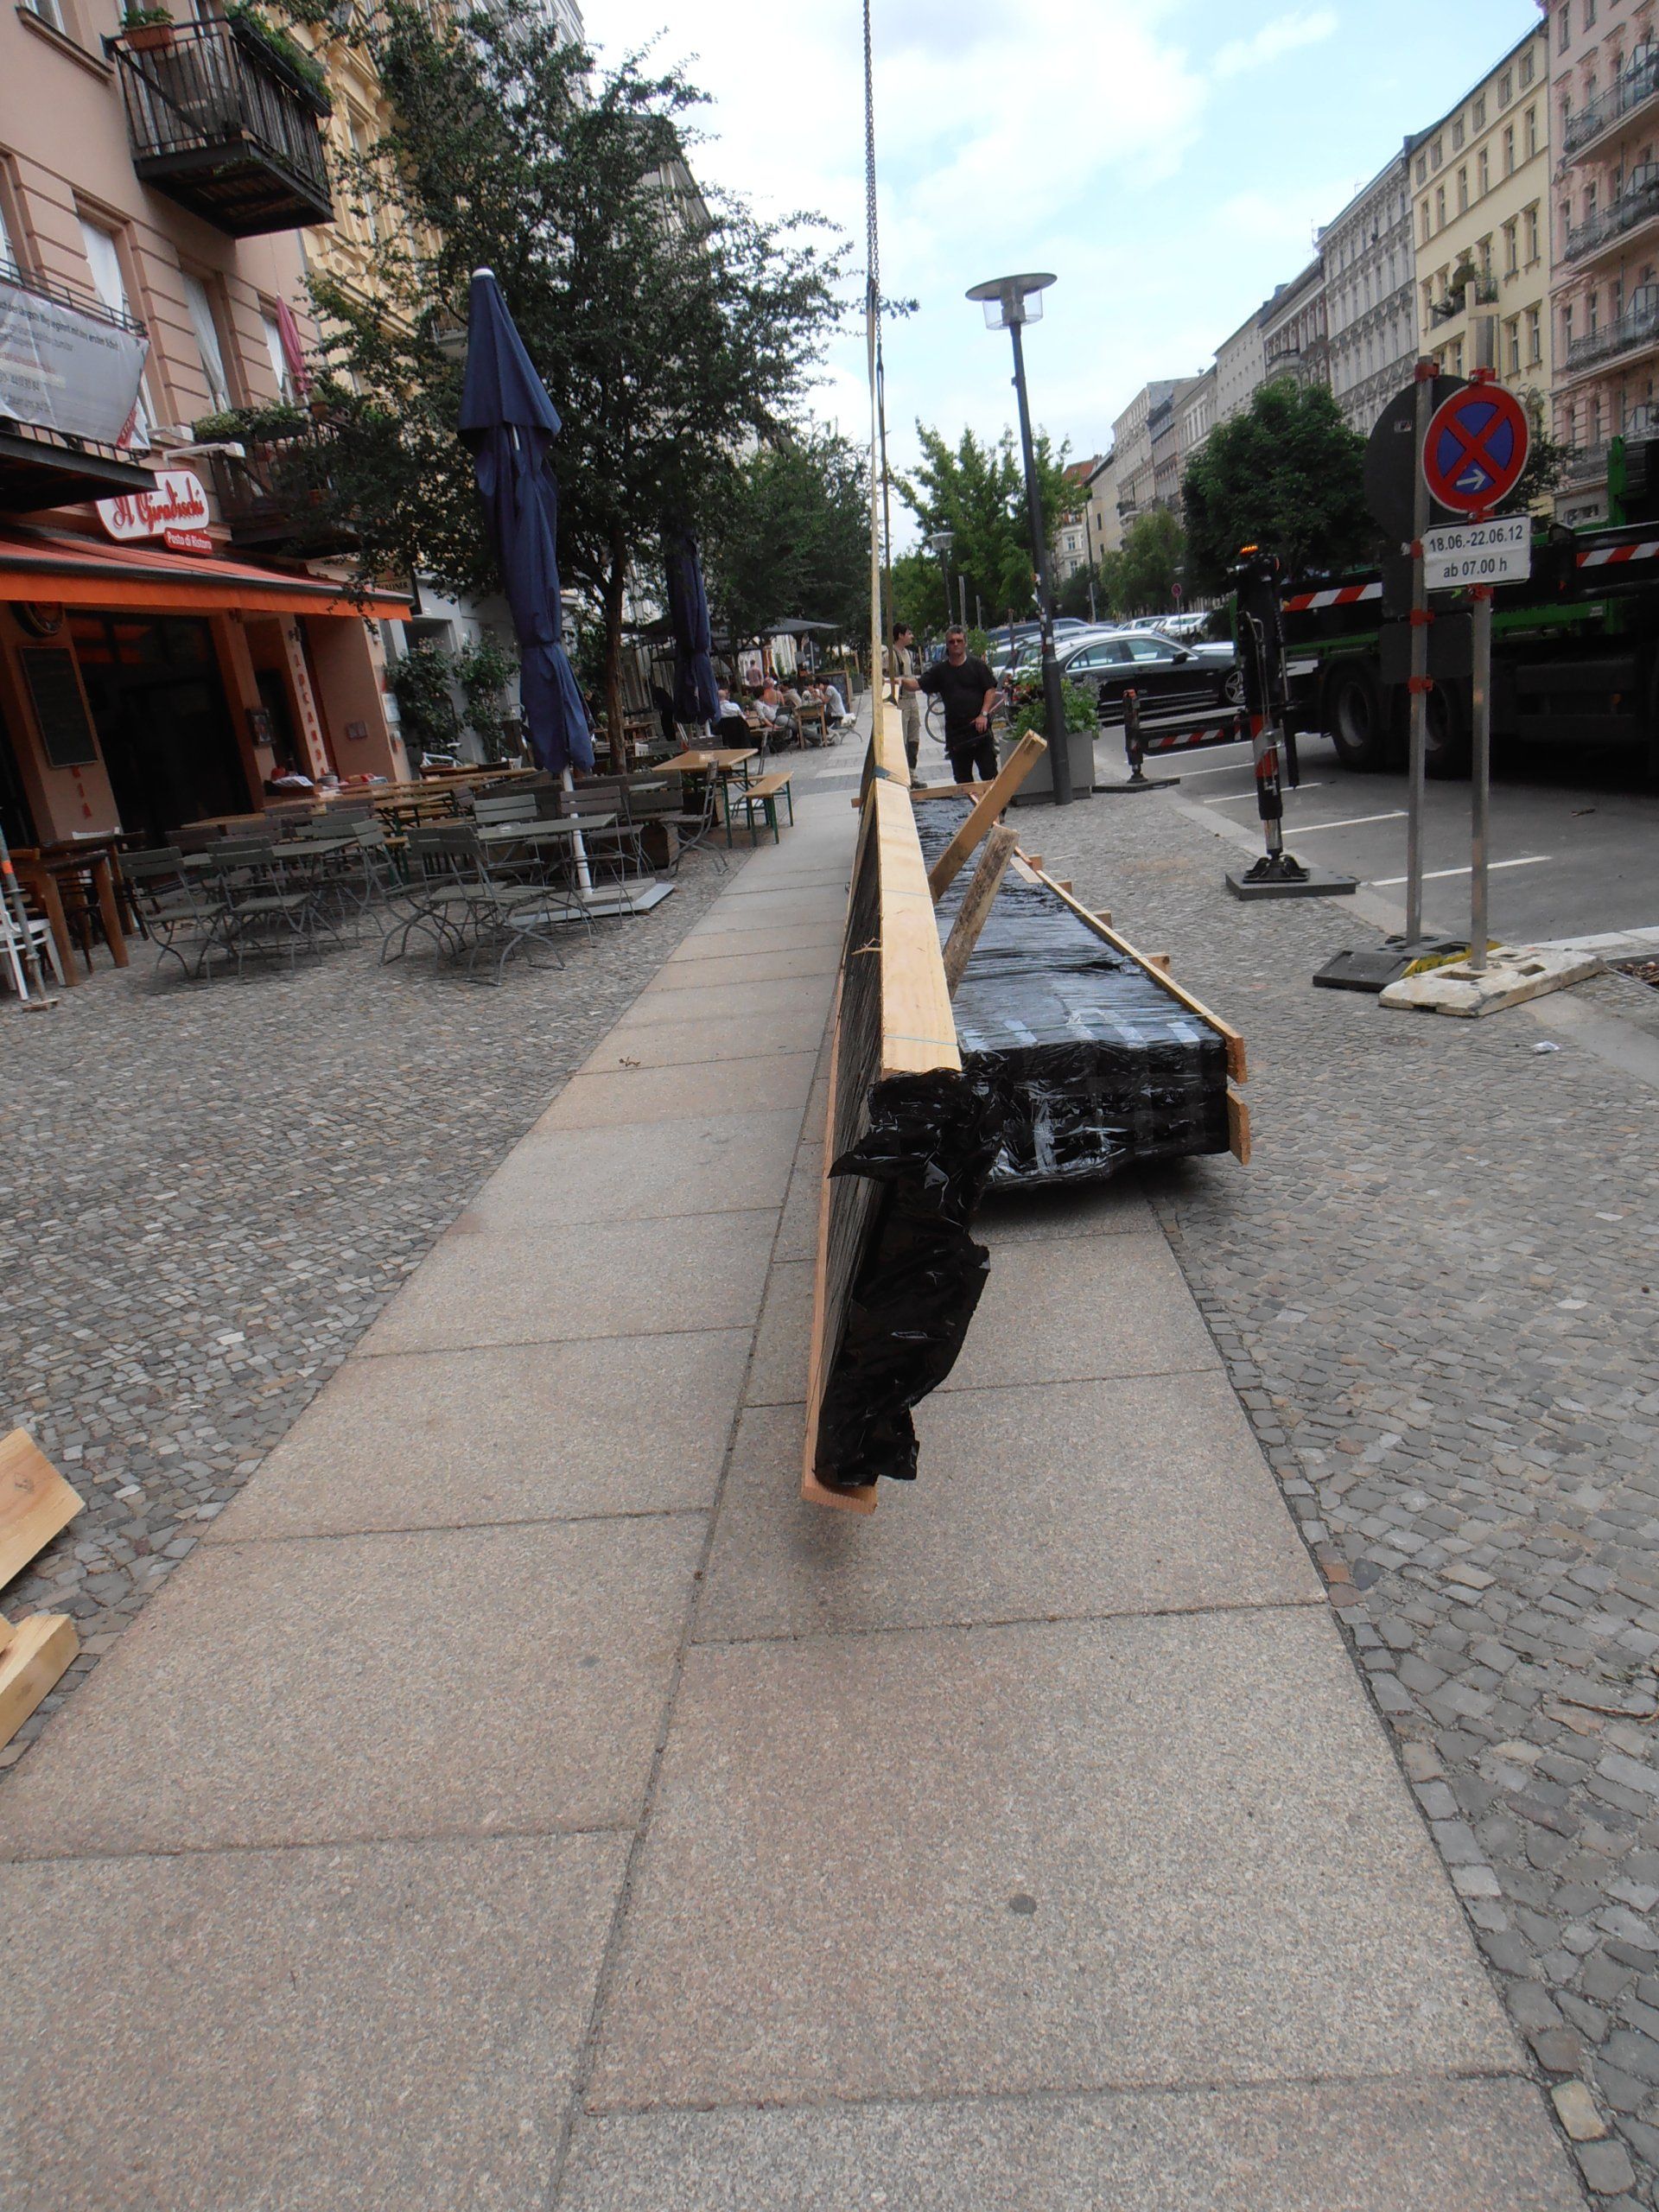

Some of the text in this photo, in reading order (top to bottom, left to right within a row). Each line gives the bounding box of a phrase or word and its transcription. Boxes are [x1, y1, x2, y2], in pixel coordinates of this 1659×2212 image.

[185, 534, 192, 547] di
[1430, 524, 1522, 552] 18.06.-22.06.12
[1443, 557, 1508, 577] ab 07.00 h
